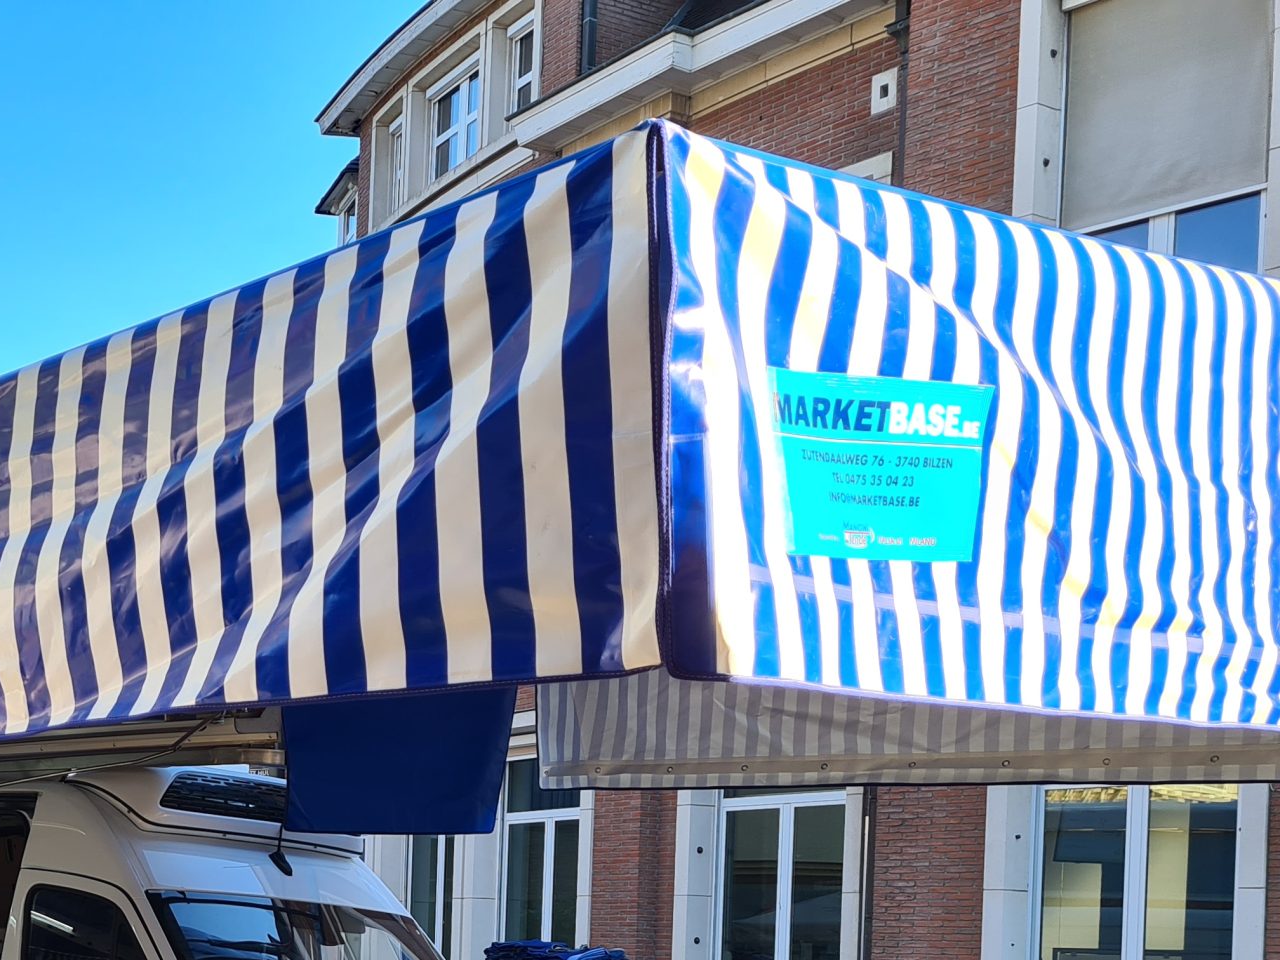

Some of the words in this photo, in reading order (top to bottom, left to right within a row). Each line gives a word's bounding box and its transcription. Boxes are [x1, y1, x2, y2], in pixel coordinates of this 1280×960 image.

[871, 454, 885, 467] 76
[895, 456, 920, 468] 3740
[923, 456, 953, 469] BILZEN
[845, 474, 867, 486] 0475
[870, 475, 883, 487] 35
[886, 475, 900, 487] 04
[902, 476, 915, 487] 23
